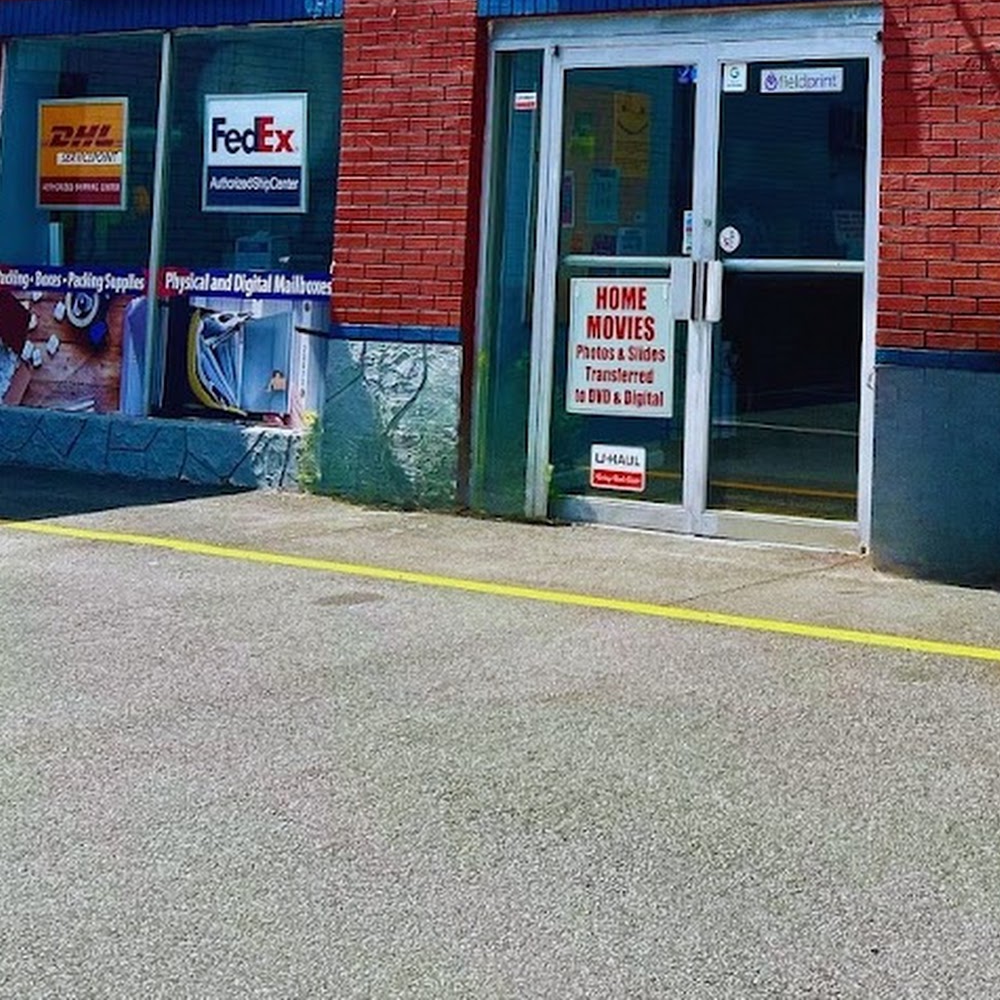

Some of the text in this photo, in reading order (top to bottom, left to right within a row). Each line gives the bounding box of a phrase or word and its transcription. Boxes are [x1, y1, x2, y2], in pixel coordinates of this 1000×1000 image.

[779, 74, 838, 89] fieldprint
[49, 124, 115, 148] DHL
[211, 116, 295, 155] FedEx
[0, 269, 29, 290] acking
[67, 271, 104, 293] Packing
[105, 273, 146, 293] Supplies
[165, 271, 332, 297] Physical and Digital Mailboxes
[596, 286, 647, 311] HOME
[586, 315, 656, 341] MOVIES
[576, 344, 666, 362] Photos & Slides
[585, 366, 655, 385] Transferred
[575, 388, 664, 408] to DVD & Digital
[594, 452, 640, 467] U-HAUL
